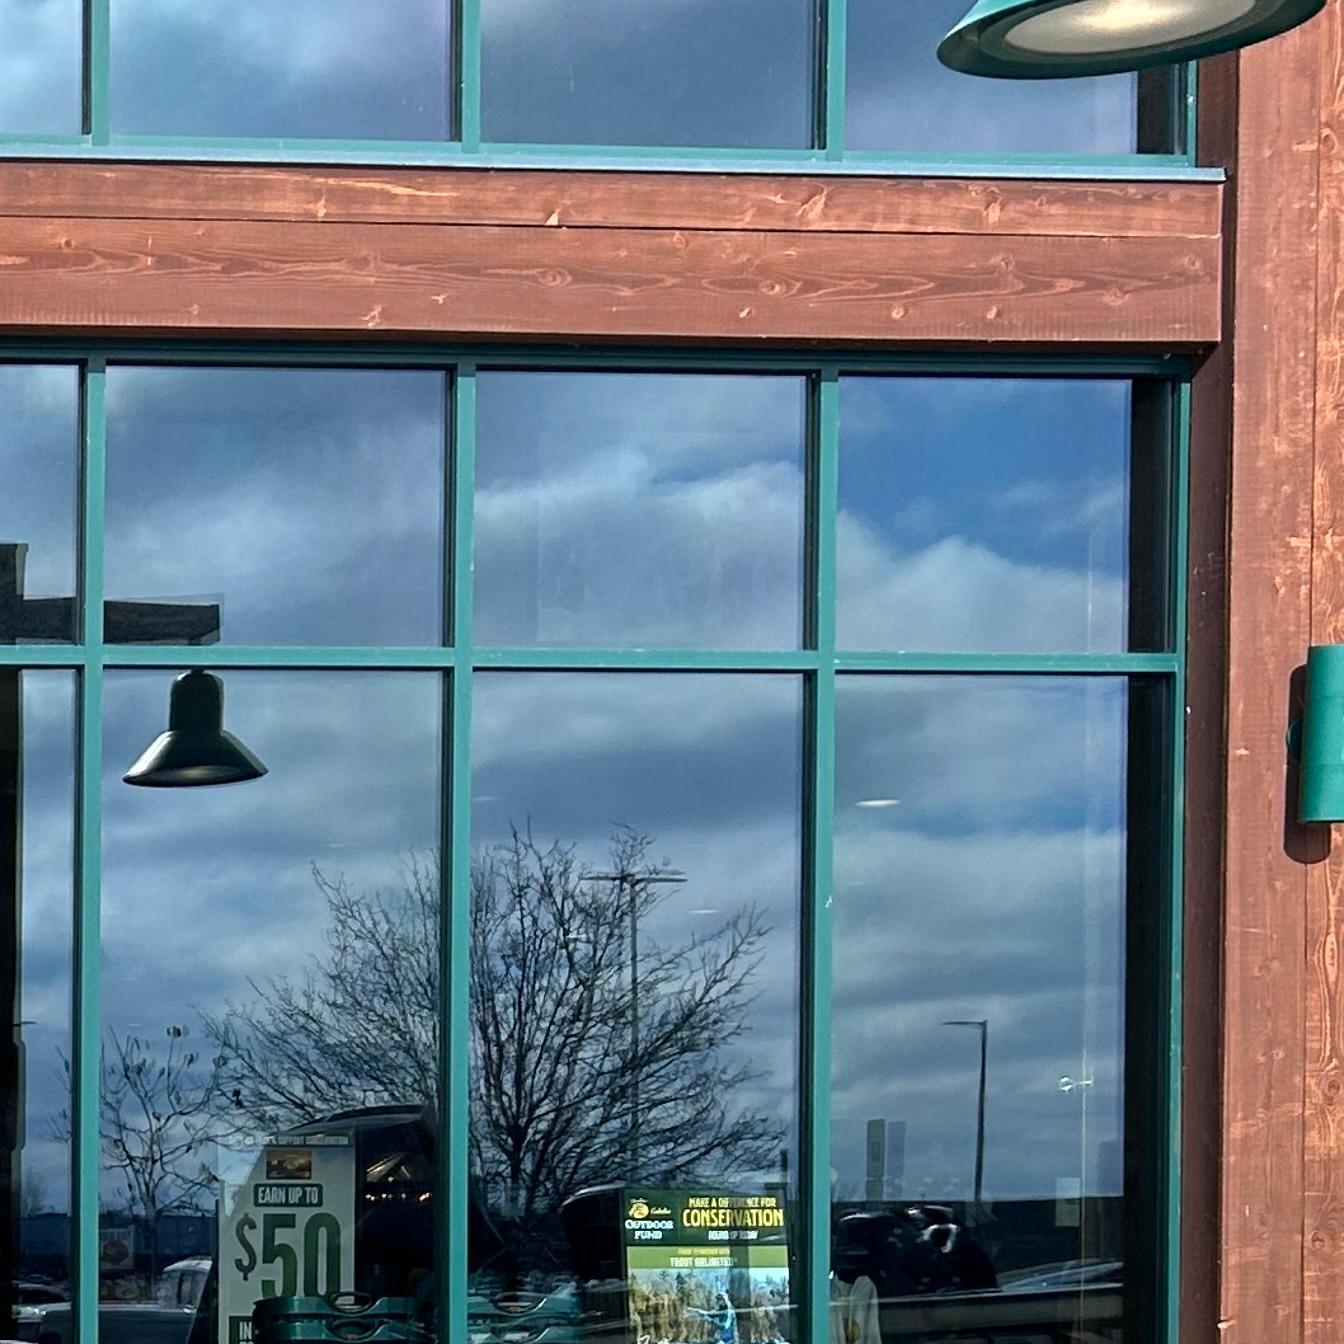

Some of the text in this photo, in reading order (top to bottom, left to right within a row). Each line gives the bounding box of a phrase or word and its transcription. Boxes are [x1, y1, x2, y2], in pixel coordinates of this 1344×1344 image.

[257, 1187, 318, 1204] EARN UP TO
[682, 1208, 784, 1227] CONSERVATION
[235, 1212, 341, 1298] $50
